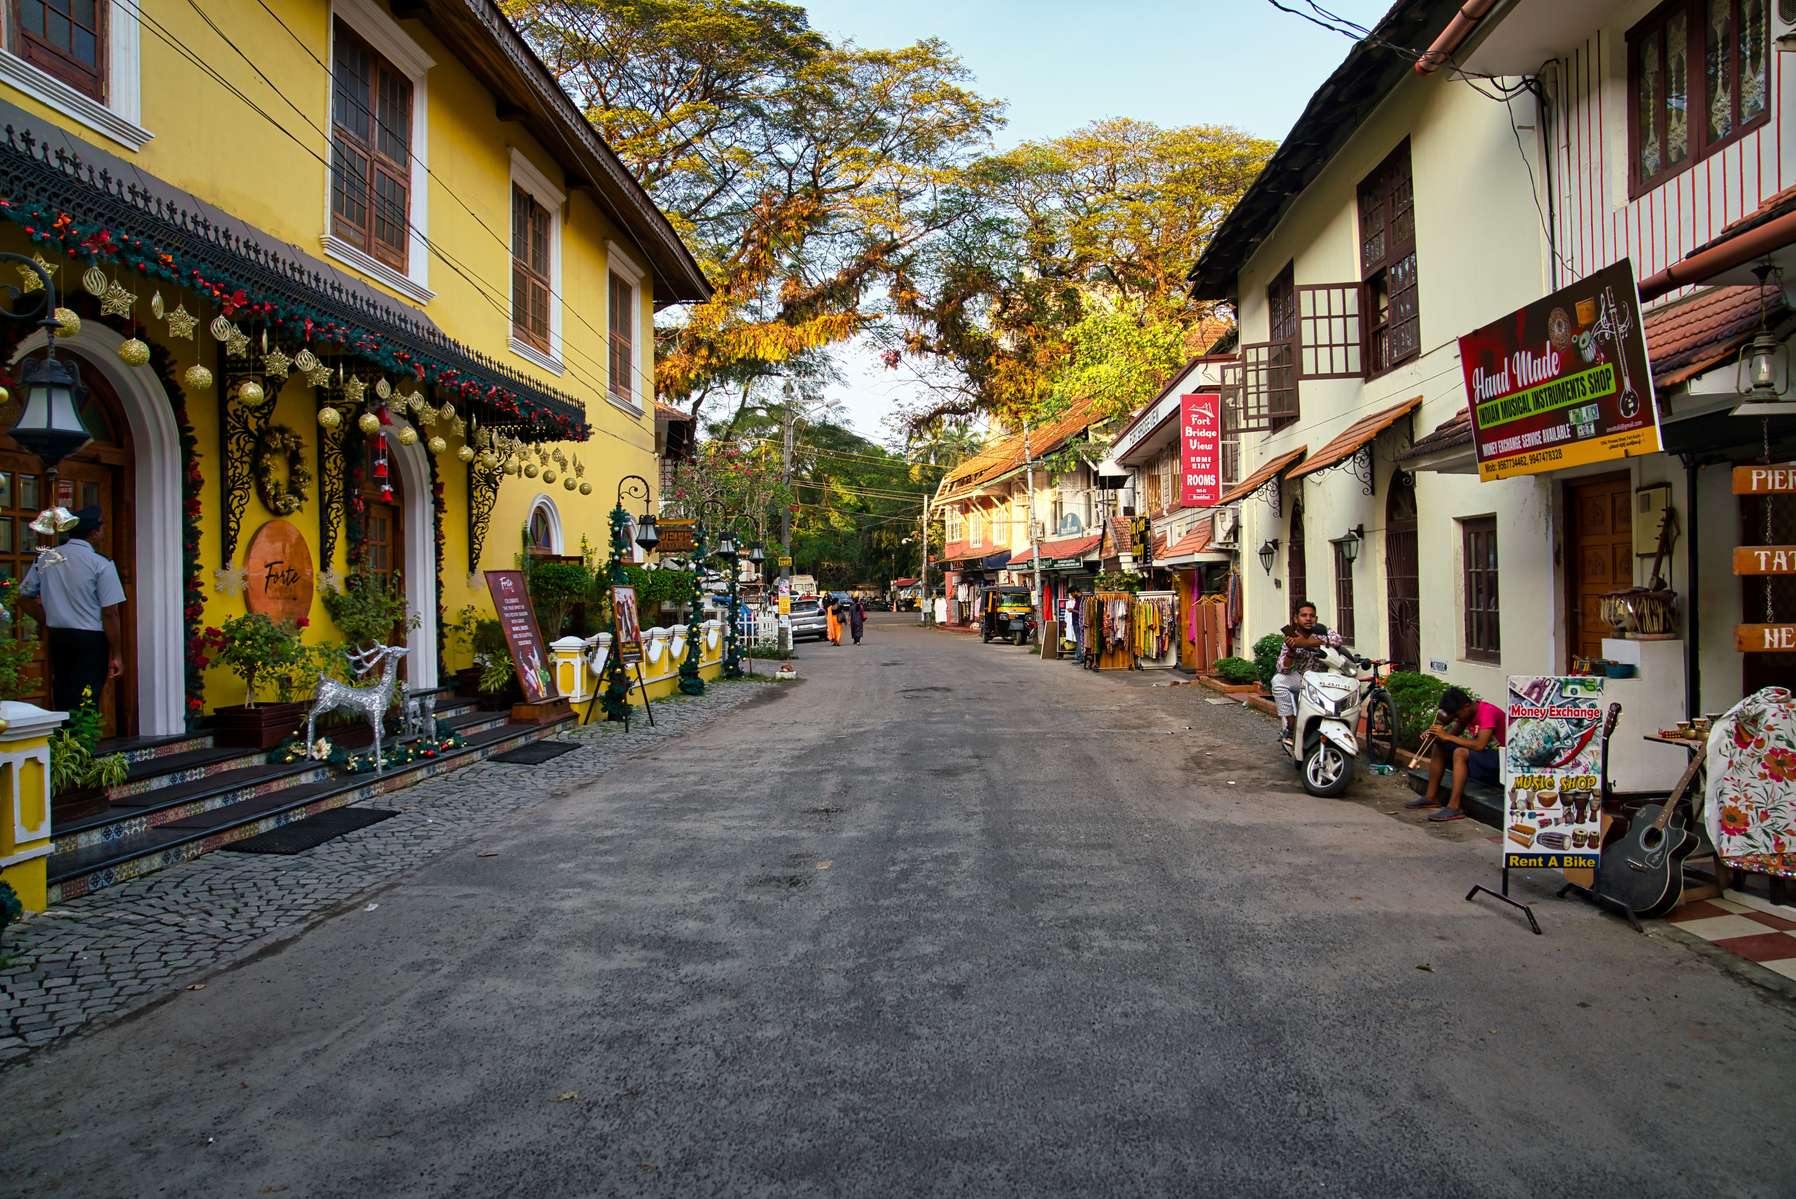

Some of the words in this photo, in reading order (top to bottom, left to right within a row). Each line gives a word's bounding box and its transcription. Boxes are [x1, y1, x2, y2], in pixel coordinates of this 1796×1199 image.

[1472, 357, 1510, 404] Hand
[1512, 340, 1561, 387] Made
[1478, 403, 1501, 426] INDIAN
[1501, 394, 1532, 419] MUSICAL
[1531, 378, 1587, 411] INSTRUMENTS
[1587, 367, 1612, 395] SHOP
[1190, 414, 1212, 426] Fort
[1185, 426, 1217, 439] Bridge
[1542, 423, 1572, 444] AVAILABLE
[1189, 439, 1213, 451] View
[1187, 474, 1216, 486] ROOMS
[264, 560, 301, 594] Forte
[1510, 704, 1547, 721] Money
[1549, 704, 1601, 721] Exchange
[1513, 774, 1556, 793] MUSIC
[1559, 774, 1598, 793] SHOP
[1508, 856, 1544, 868] Rent
[1547, 856, 1559, 868] A
[1563, 855, 1596, 868] Bike
